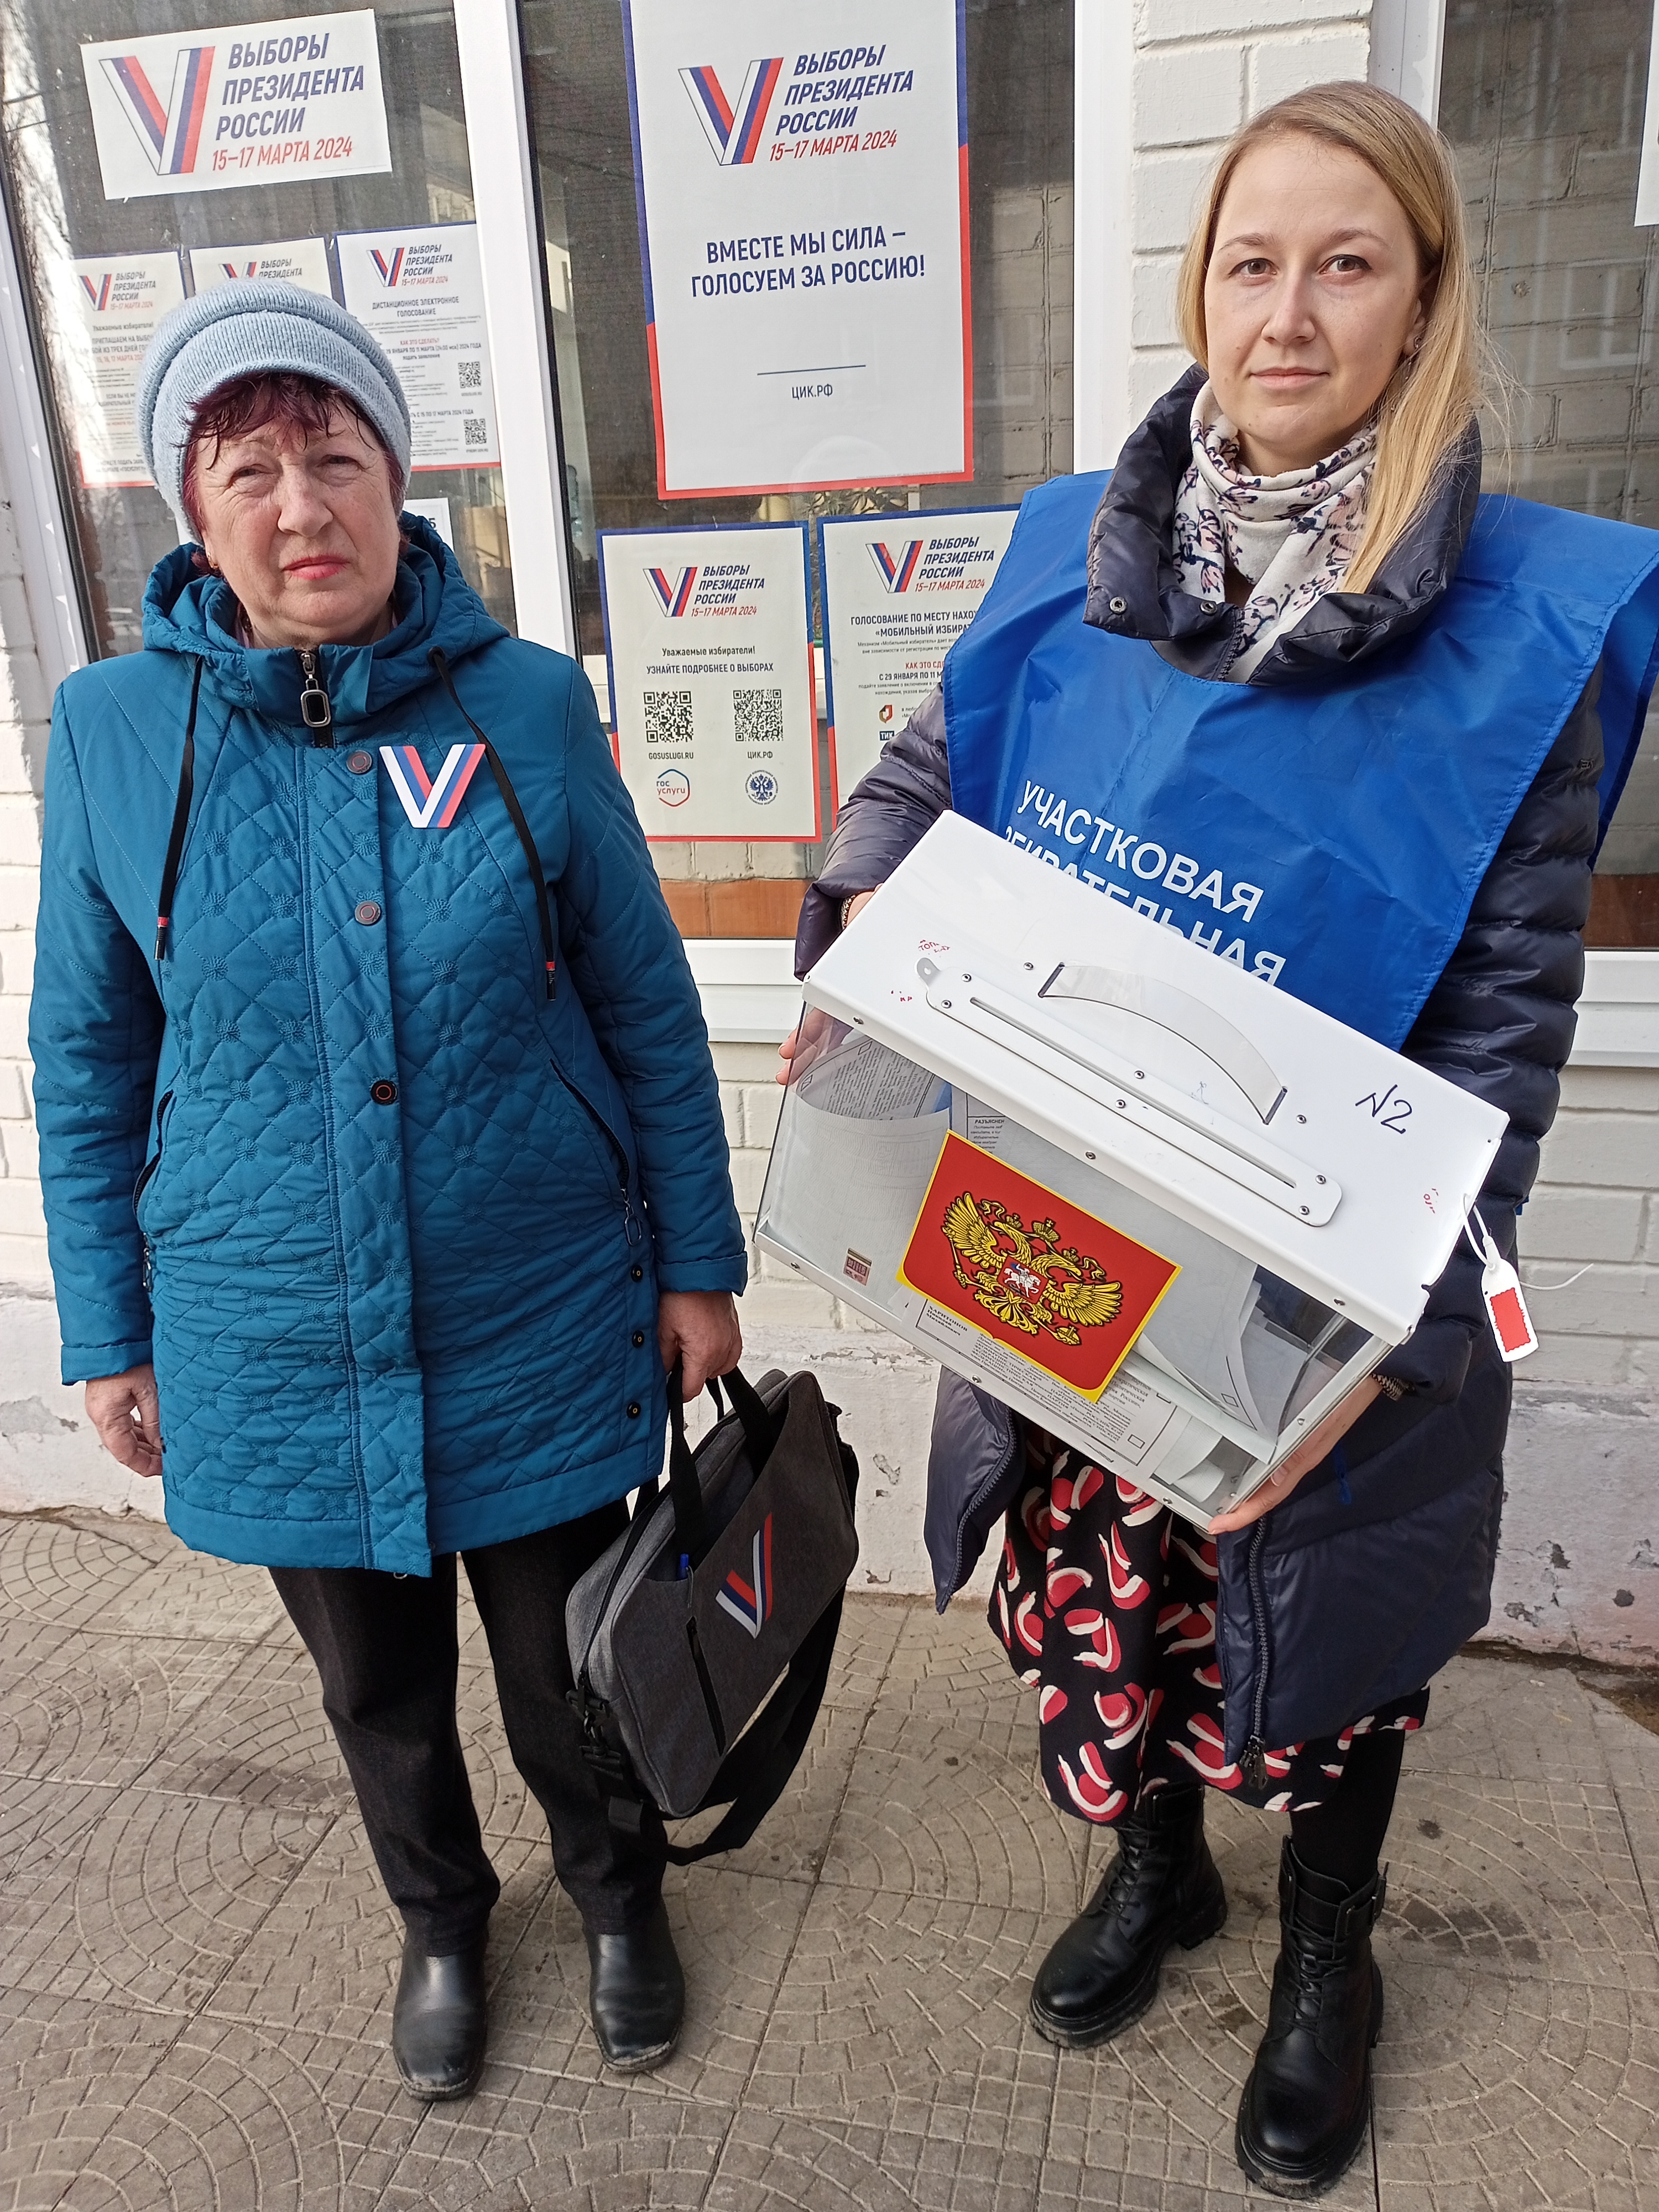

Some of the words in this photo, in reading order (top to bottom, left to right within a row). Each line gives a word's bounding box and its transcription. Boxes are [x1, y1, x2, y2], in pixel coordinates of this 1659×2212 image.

[228, 33, 330, 69] ВЫБОРЫ
[793, 45, 886, 76] ВЫБОРЫ
[222, 65, 364, 105] ПРЕЗИДЕНТА
[784, 70, 914, 106] ПРЕЗИДЕНТА
[216, 108, 305, 140] РОССИИ
[775, 106, 858, 135] РОССИИ
[810, 134, 860, 156] МАРТА
[862, 130, 897, 151] 2024
[257, 140, 310, 166] МАРТА
[314, 136, 352, 160] 2024
[409, 244, 442, 255] ВЫБОРЫ
[706, 236, 784, 263] ВМЕСТЕ
[790, 232, 826, 255] МЫ
[832, 226, 886, 250] СИЛА
[261, 258, 292, 269] ВЫБОРЫ
[406, 254, 452, 266] ПРЕЗИДЕНТА
[116, 271, 145, 281] ВЫБОРЫ
[259, 268, 302, 278] ПРЕЗИДЕНТА
[403, 267, 434, 276] РОССИИ
[691, 269, 795, 297] ГОЛОСУЕМ
[801, 267, 825, 286] ЗА
[831, 255, 925, 284] РОССИЮ!
[113, 281, 156, 291] ПРЕЗИДЕНТА
[112, 293, 139, 301] РОССИИ
[372, 300, 419, 310] ДИСТАНЦИОННОЕ
[420, 296, 460, 305] ЭЛЕКТРОННОЕ
[397, 308, 436, 317] ГОЛОСОВАНИЕ
[791, 384, 833, 400] ЦИК.РФ
[929, 536, 980, 550] ВЫБОРЫ
[924, 550, 995, 565] ПРЕЗИДЕНТА
[703, 565, 750, 576] ВЫБОРЫ
[919, 566, 964, 580] РОССИИ
[698, 578, 765, 591] ПРЕЗИДЕНТА
[937, 580, 964, 591] МАРТА
[966, 579, 985, 589] 2024
[694, 593, 737, 604] РОССИИ
[712, 607, 737, 616] МАРТА
[738, 606, 757, 615] 2024
[851, 614, 909, 625] ГОЛОСОВАНИЕ
[911, 613, 921, 622] ПО
[924, 612, 951, 622] МЕСТУ
[875, 624, 934, 637] «МОБИЛЬНЫЙ
[662, 648, 707, 656] Уважаемые
[709, 646, 755, 656] избиратели!
[646, 664, 680, 674] УЗНАЙТЕ
[682, 664, 728, 674] ПОДРОБНЕЕ
[730, 664, 735, 672] О
[737, 663, 774, 672] ВЫБОРАХ
[747, 751, 773, 760] ЦИК.РФ
[1018, 780, 1264, 923] УЧАСТКОВАЯ
